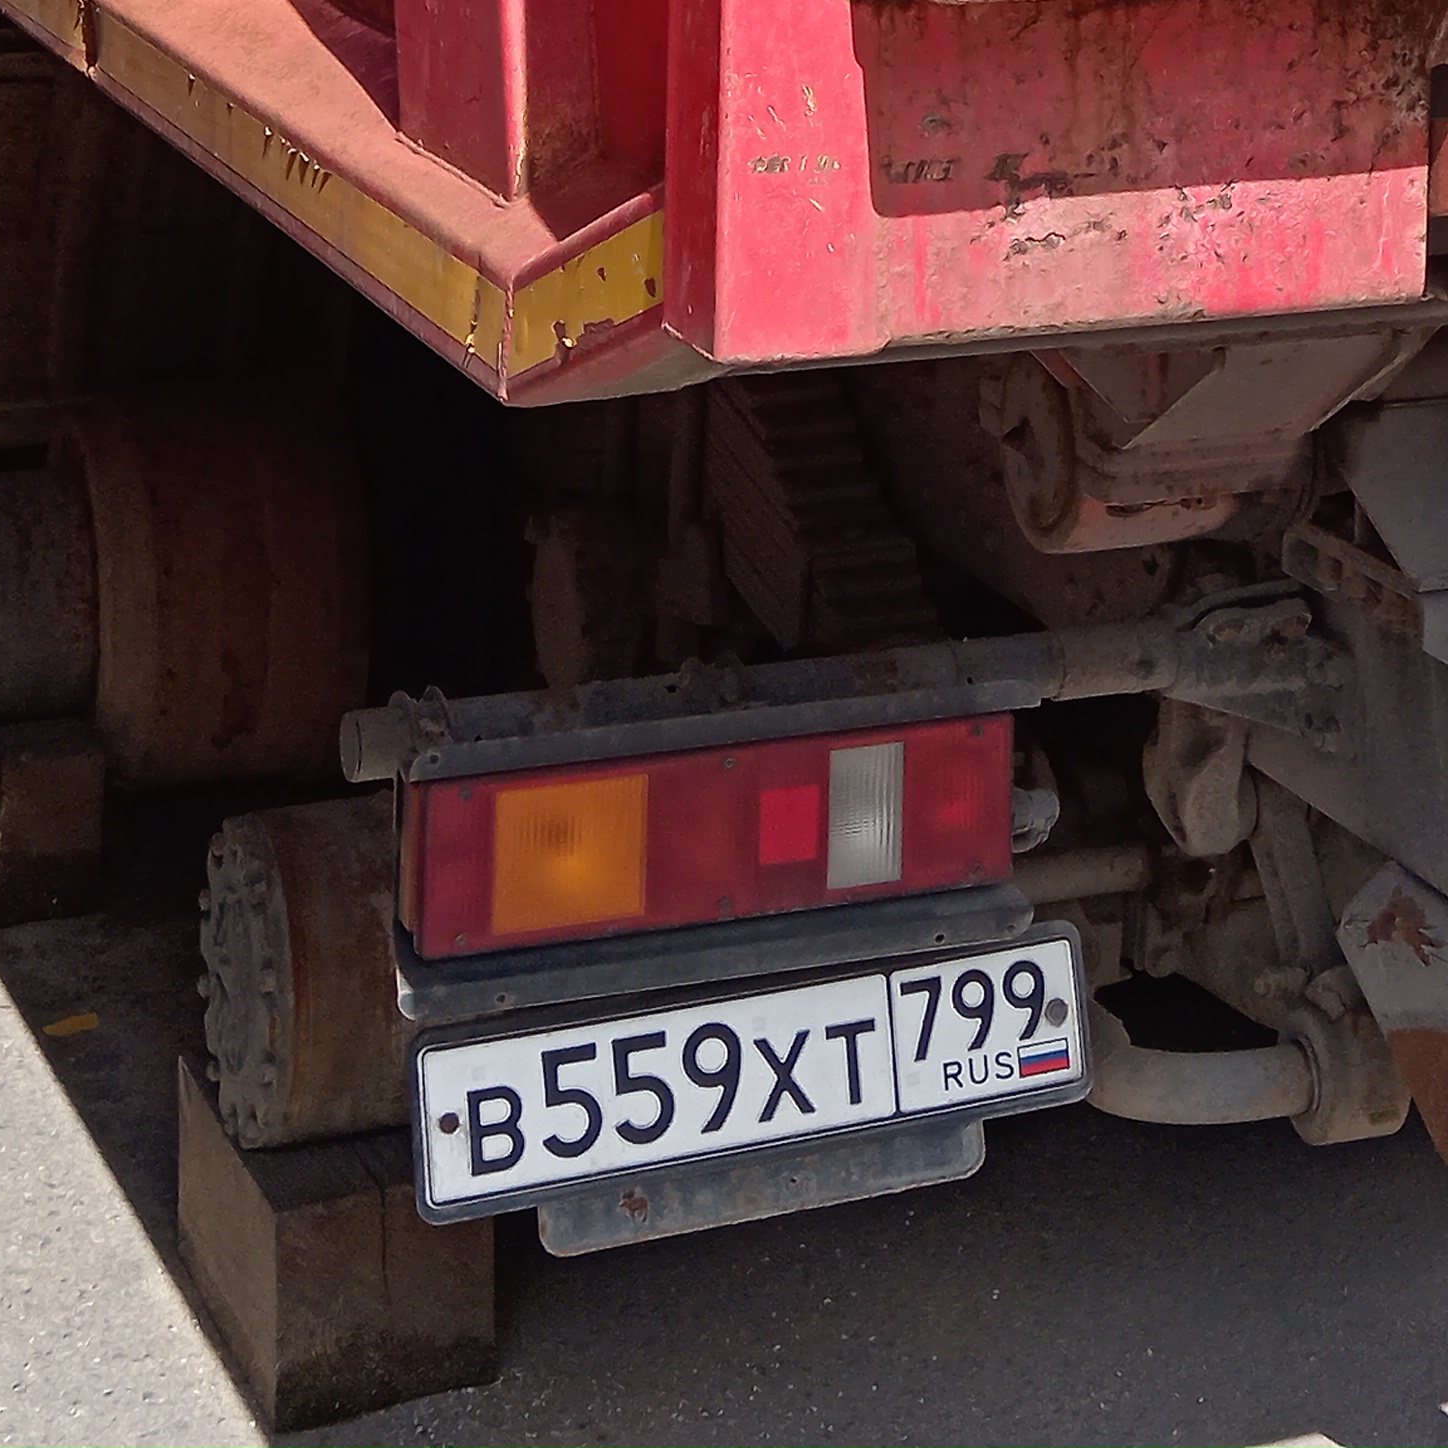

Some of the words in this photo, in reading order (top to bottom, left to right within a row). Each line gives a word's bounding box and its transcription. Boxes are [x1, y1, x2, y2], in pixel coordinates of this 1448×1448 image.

[466, 1018, 877, 1178] В559ХТ
[898, 959, 1047, 1063] 799
[942, 1051, 1016, 1092] RUS
